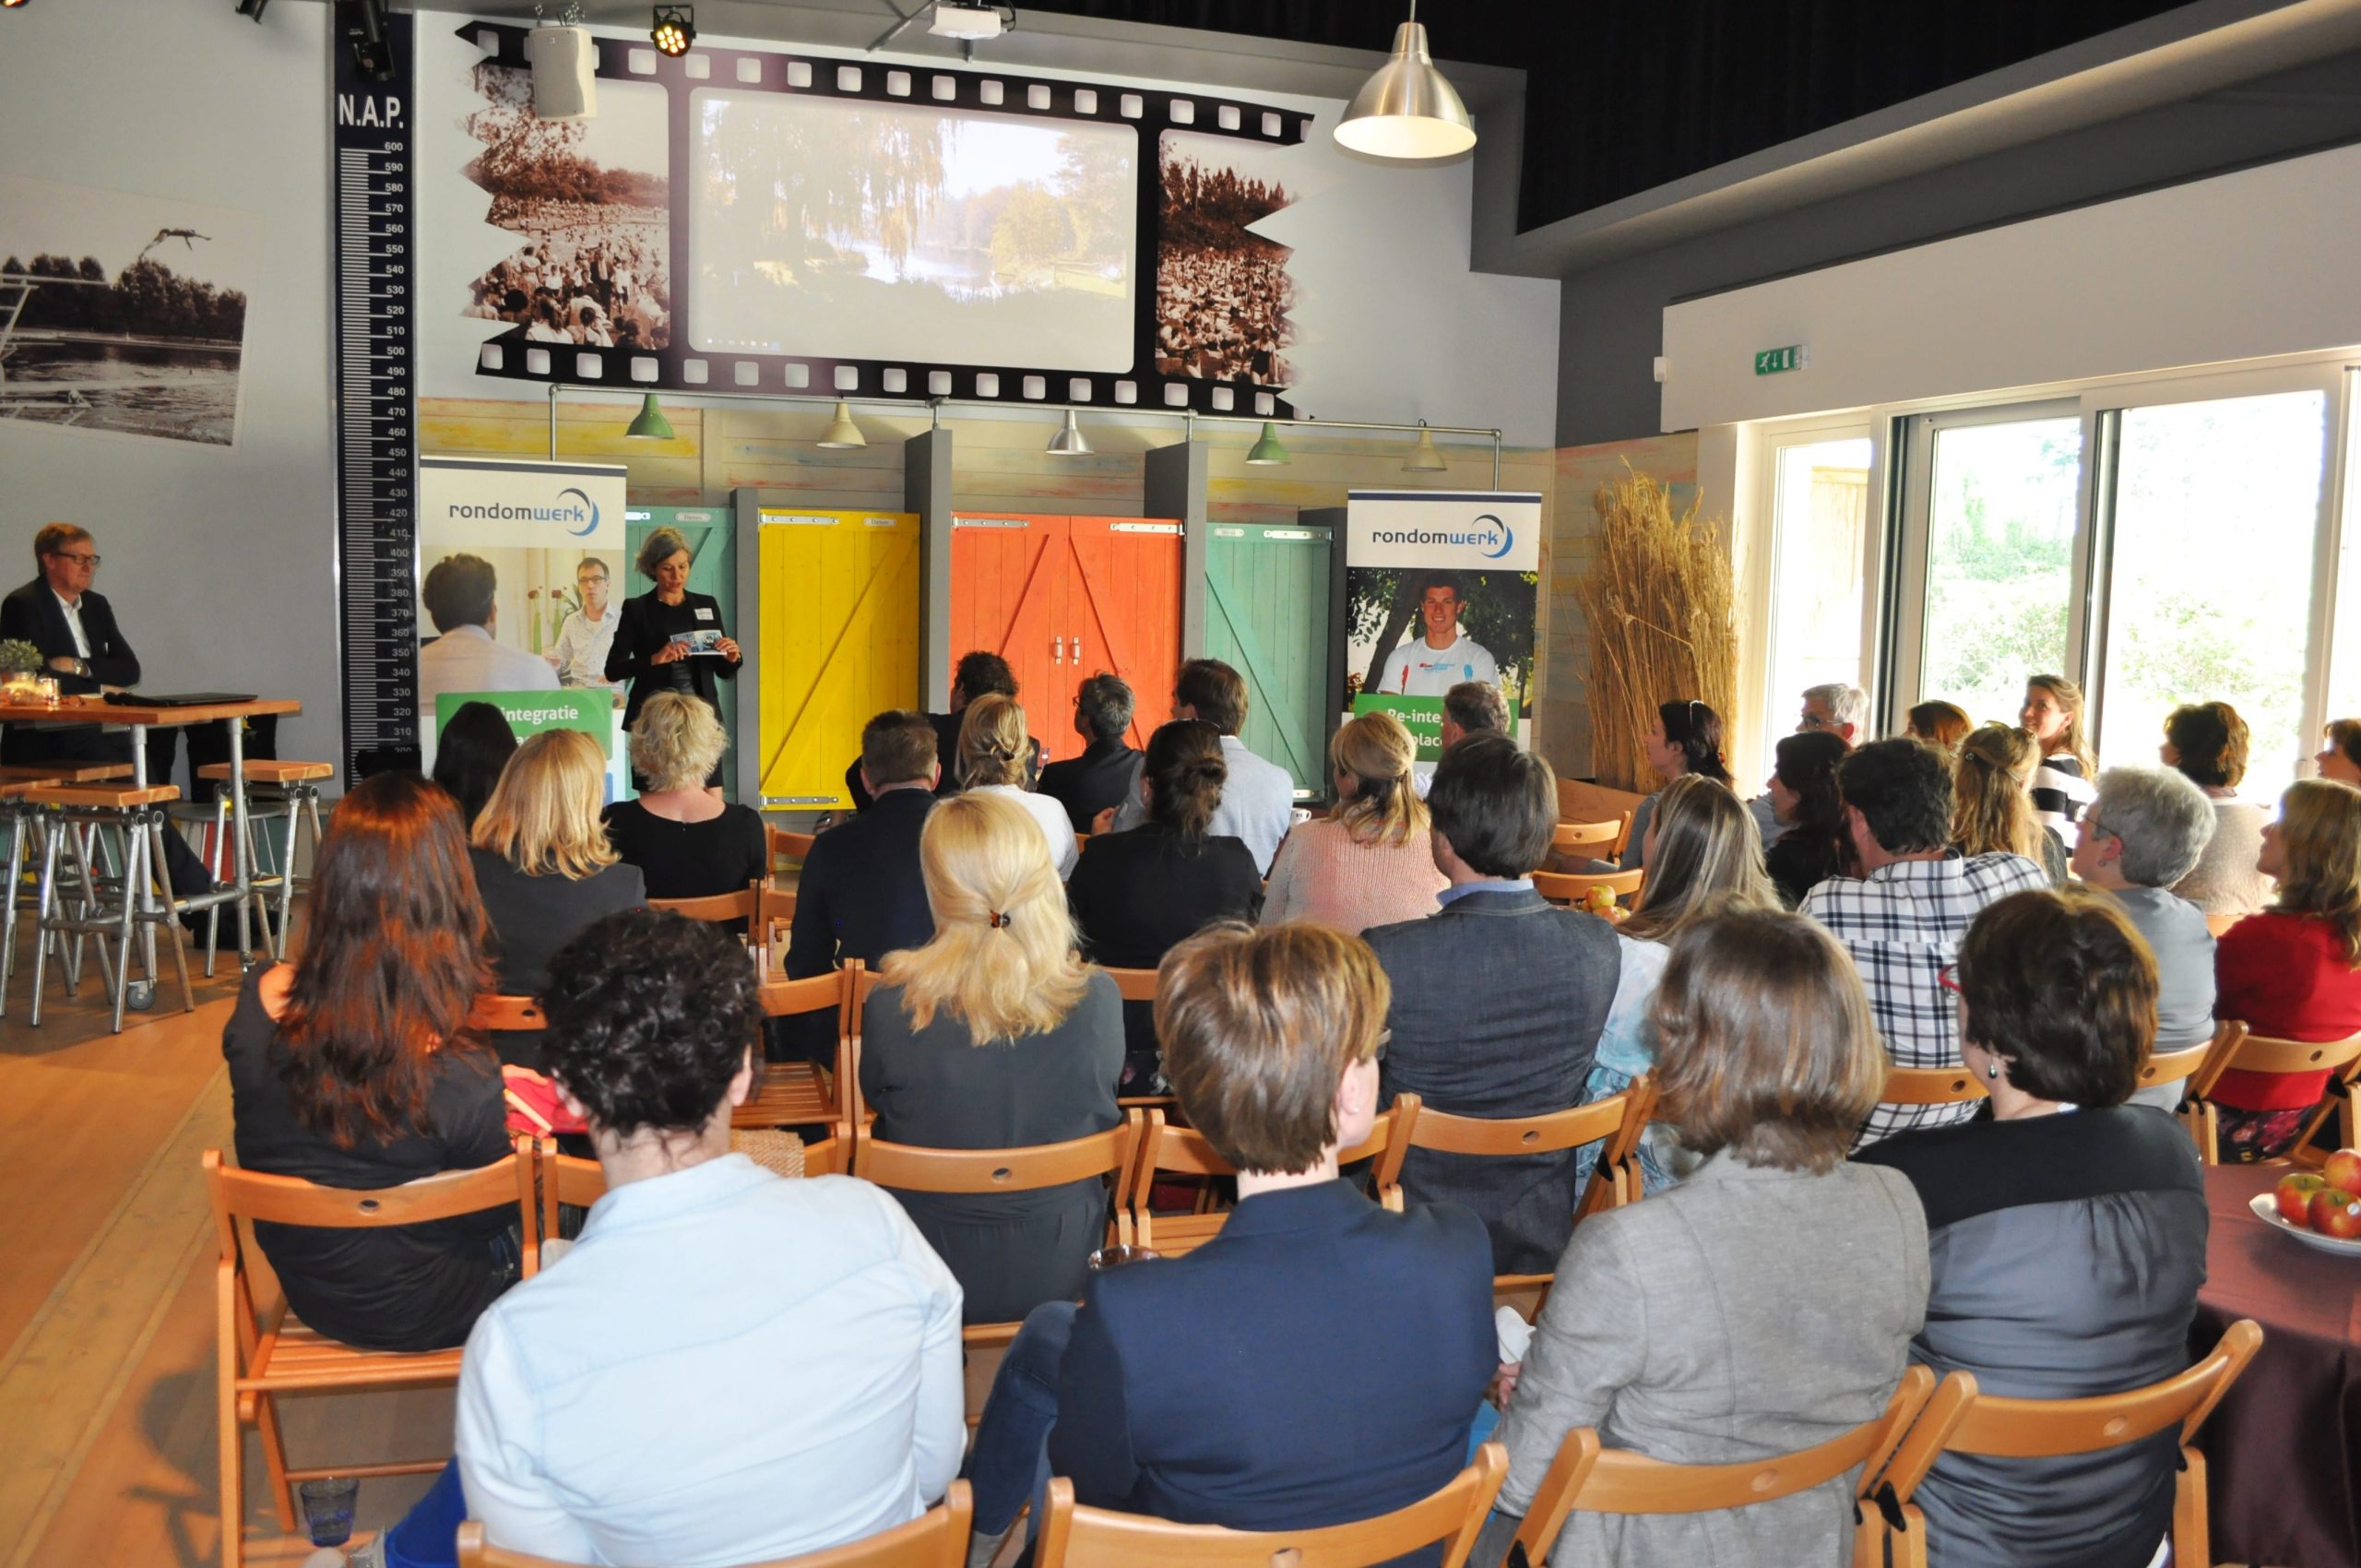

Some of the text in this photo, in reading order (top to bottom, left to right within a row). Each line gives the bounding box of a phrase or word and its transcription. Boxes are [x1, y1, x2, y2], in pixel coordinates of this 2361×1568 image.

[338, 93, 404, 129] N.A.P.
[385, 142, 403, 151] 600
[385, 162, 403, 172] 590
[385, 184, 403, 192] 580
[386, 204, 403, 212] 570
[386, 224, 404, 233] 560
[386, 244, 404, 254] 550
[386, 266, 404, 274] 540
[386, 286, 404, 294] 530
[386, 306, 404, 315] 520
[386, 327, 405, 335] 510
[386, 347, 405, 355] 500
[387, 367, 405, 375] 490
[387, 387, 405, 396] 480
[388, 408, 406, 416] 470
[388, 428, 406, 436] 460
[388, 448, 407, 457] 450
[389, 469, 407, 477] 440
[389, 489, 407, 497] 430
[389, 508, 408, 517] 420
[449, 502, 584, 522] rondomwerk
[1372, 529, 1498, 545] rondomwerk
[391, 568, 409, 577] 390
[391, 588, 409, 597] 380
[391, 609, 409, 617] 370
[391, 628, 409, 636] 360
[392, 648, 409, 657] 350
[392, 668, 410, 676] 340
[393, 688, 410, 696] 330
[393, 707, 411, 716] 320
[501, 705, 579, 725] integratie
